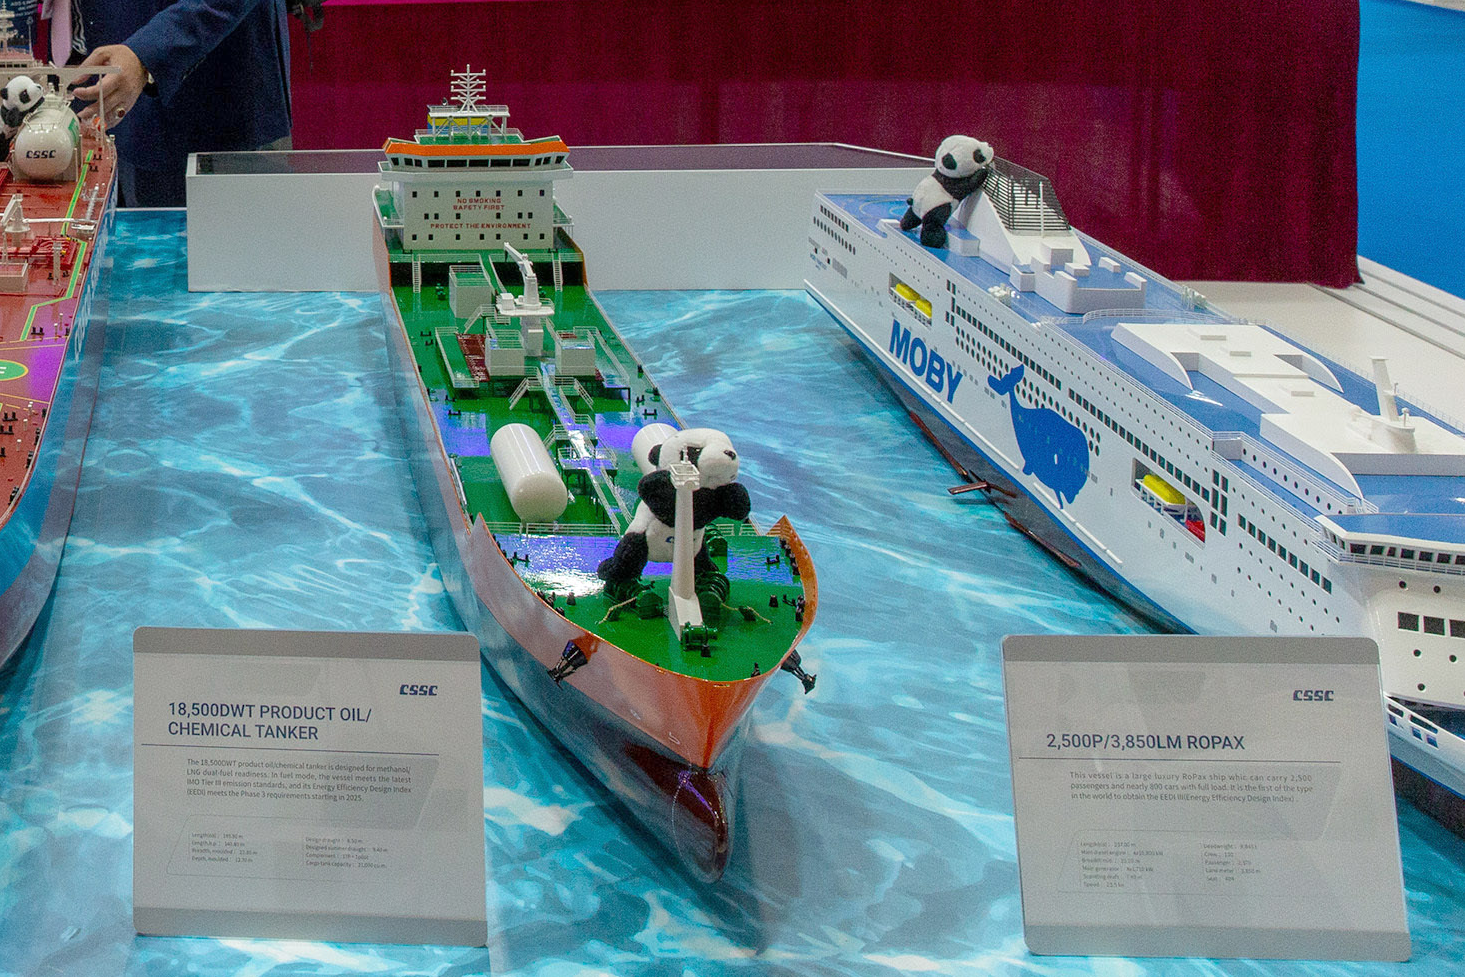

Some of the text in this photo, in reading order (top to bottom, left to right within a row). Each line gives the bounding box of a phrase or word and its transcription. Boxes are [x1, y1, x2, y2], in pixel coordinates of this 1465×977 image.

[26, 149, 57, 159] CSSC
[889, 319, 964, 404] MOBY
[399, 684, 438, 696] CSSC
[1293, 689, 1334, 701] CSSC
[168, 702, 372, 723] 18,500DWT PRODUCT OIL/
[168, 721, 318, 740] CHEMICAL TANKER
[1046, 733, 1246, 751] 2,500P/3,850LM ROPAX
